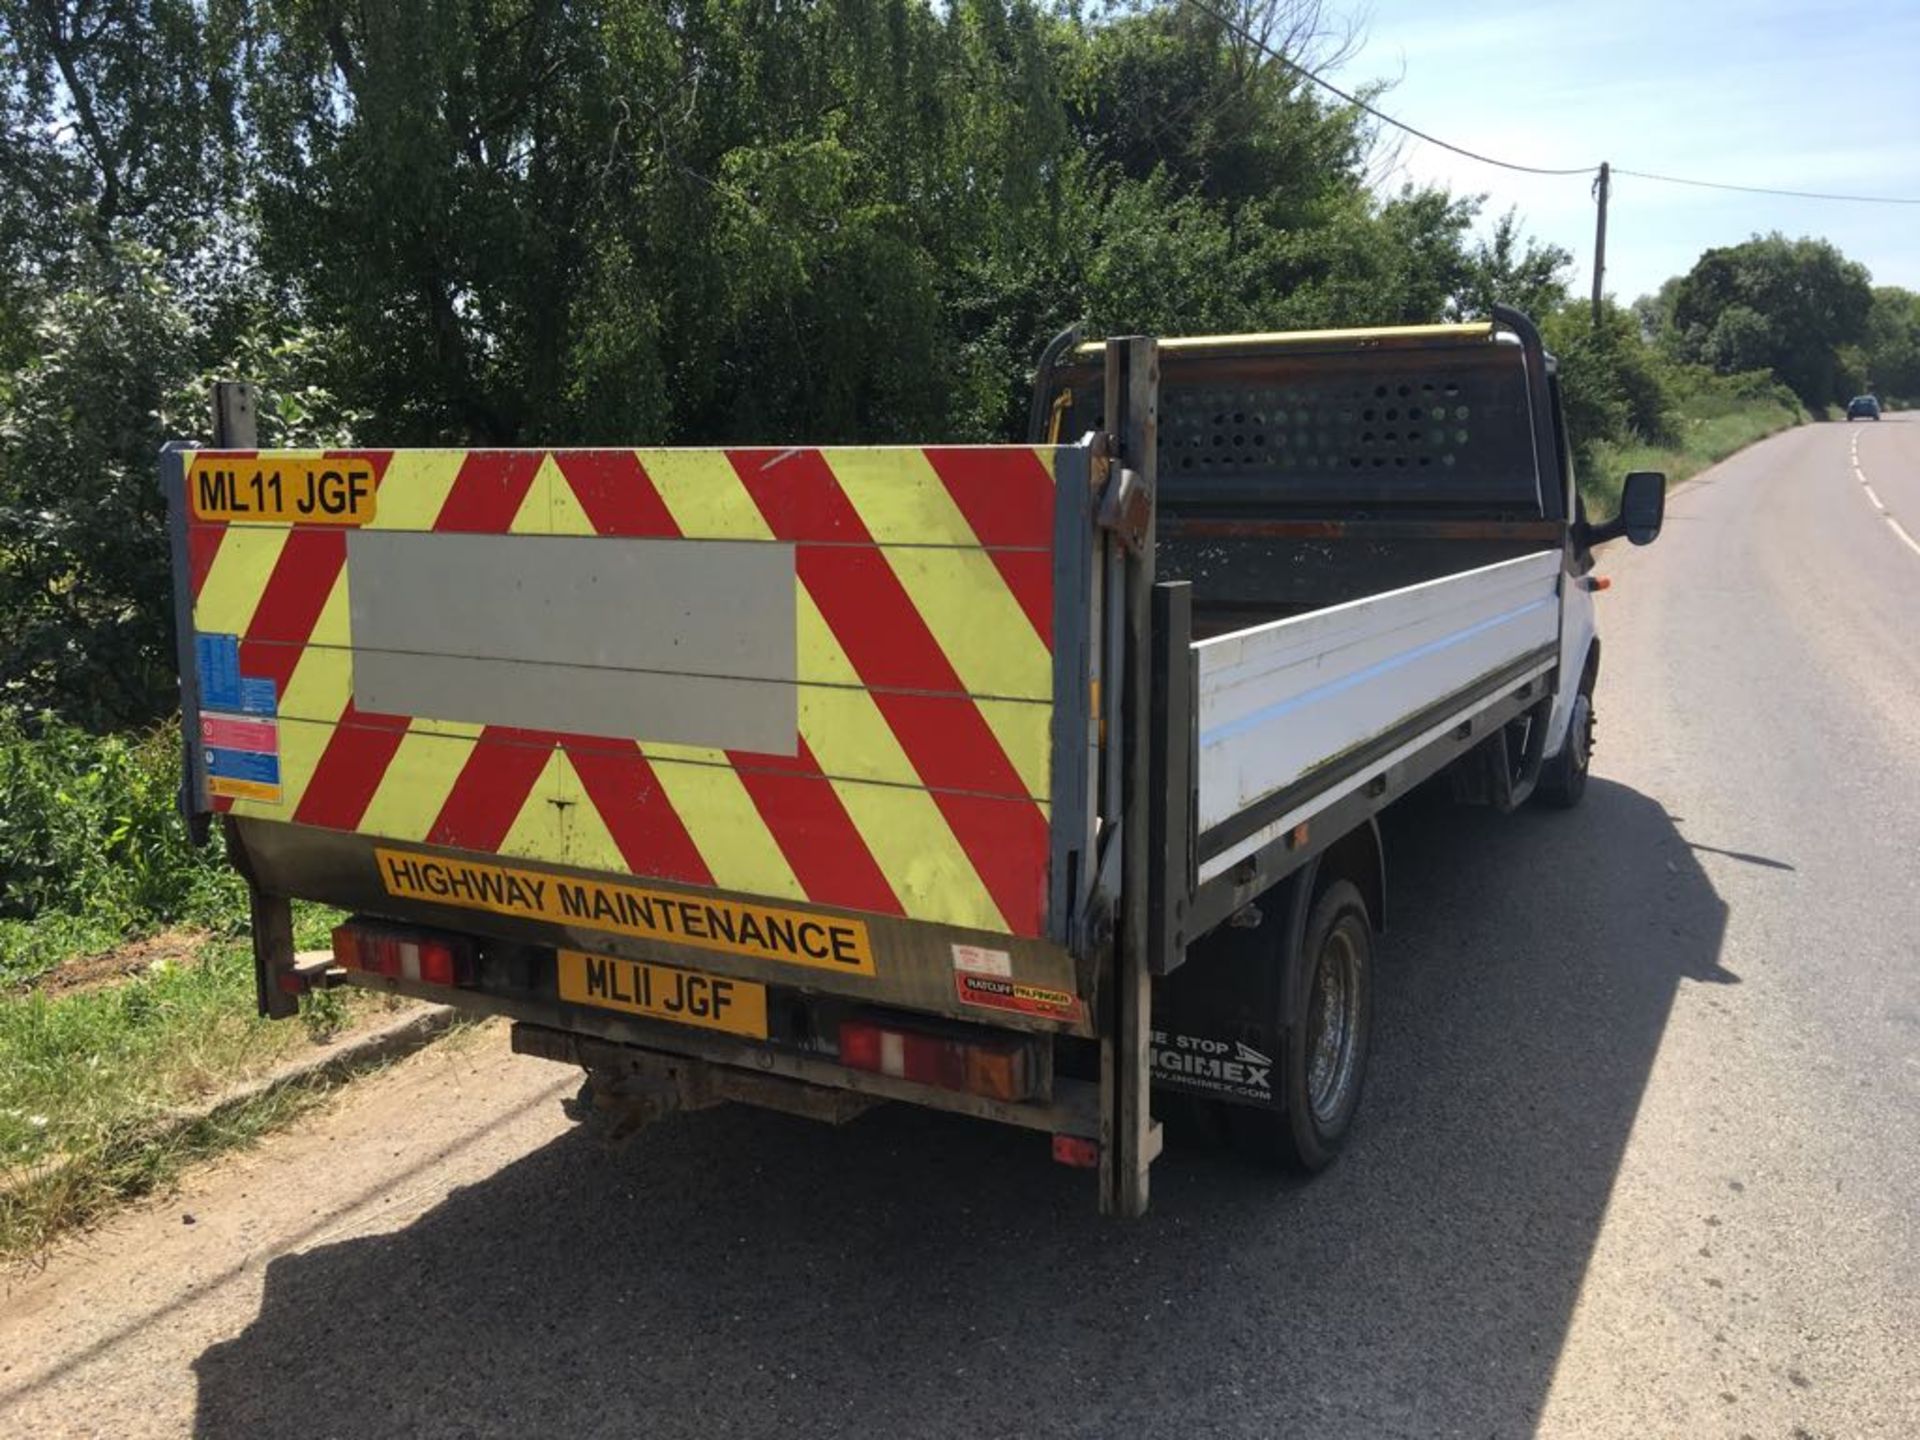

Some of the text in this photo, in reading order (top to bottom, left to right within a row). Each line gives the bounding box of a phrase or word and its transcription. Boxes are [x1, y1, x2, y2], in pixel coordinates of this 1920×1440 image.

[199, 470, 368, 515] ML11 JGF
[388, 857, 861, 965] HIGHWAY MAINTENANCE
[585, 957, 734, 1020] ML11 JGF
[1176, 1035, 1229, 1054] STOP
